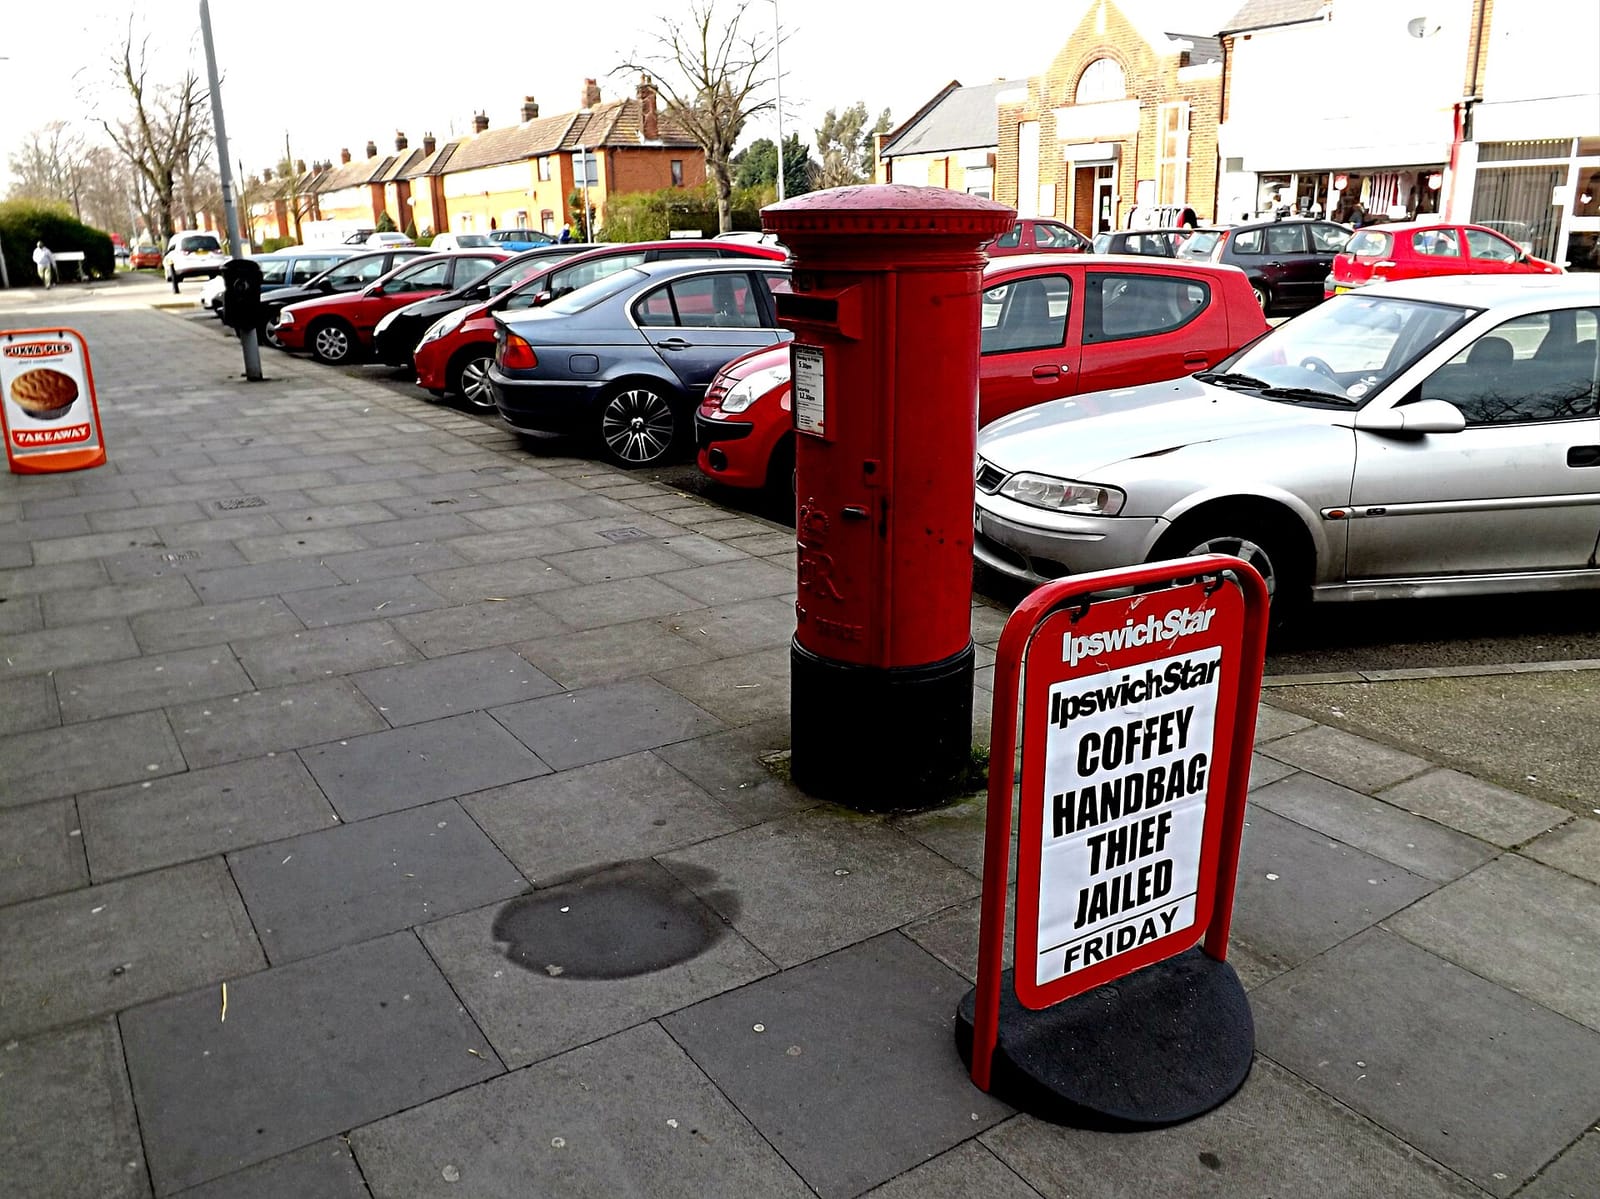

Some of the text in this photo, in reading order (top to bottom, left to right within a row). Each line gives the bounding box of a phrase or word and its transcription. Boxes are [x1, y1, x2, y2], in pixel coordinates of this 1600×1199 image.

[5, 343, 71, 356] PUKKA PIES
[17, 427, 87, 443] TAKEAWAY
[1062, 608, 1216, 667] IpswichStar
[1050, 660, 1220, 728] IpswichStar
[1076, 705, 1194, 778] COFFEY
[1052, 752, 1209, 838] HANDBAG
[1086, 811, 1173, 877] THIEF
[1073, 858, 1174, 930] JAILED
[1063, 906, 1178, 973] FRIDAY
